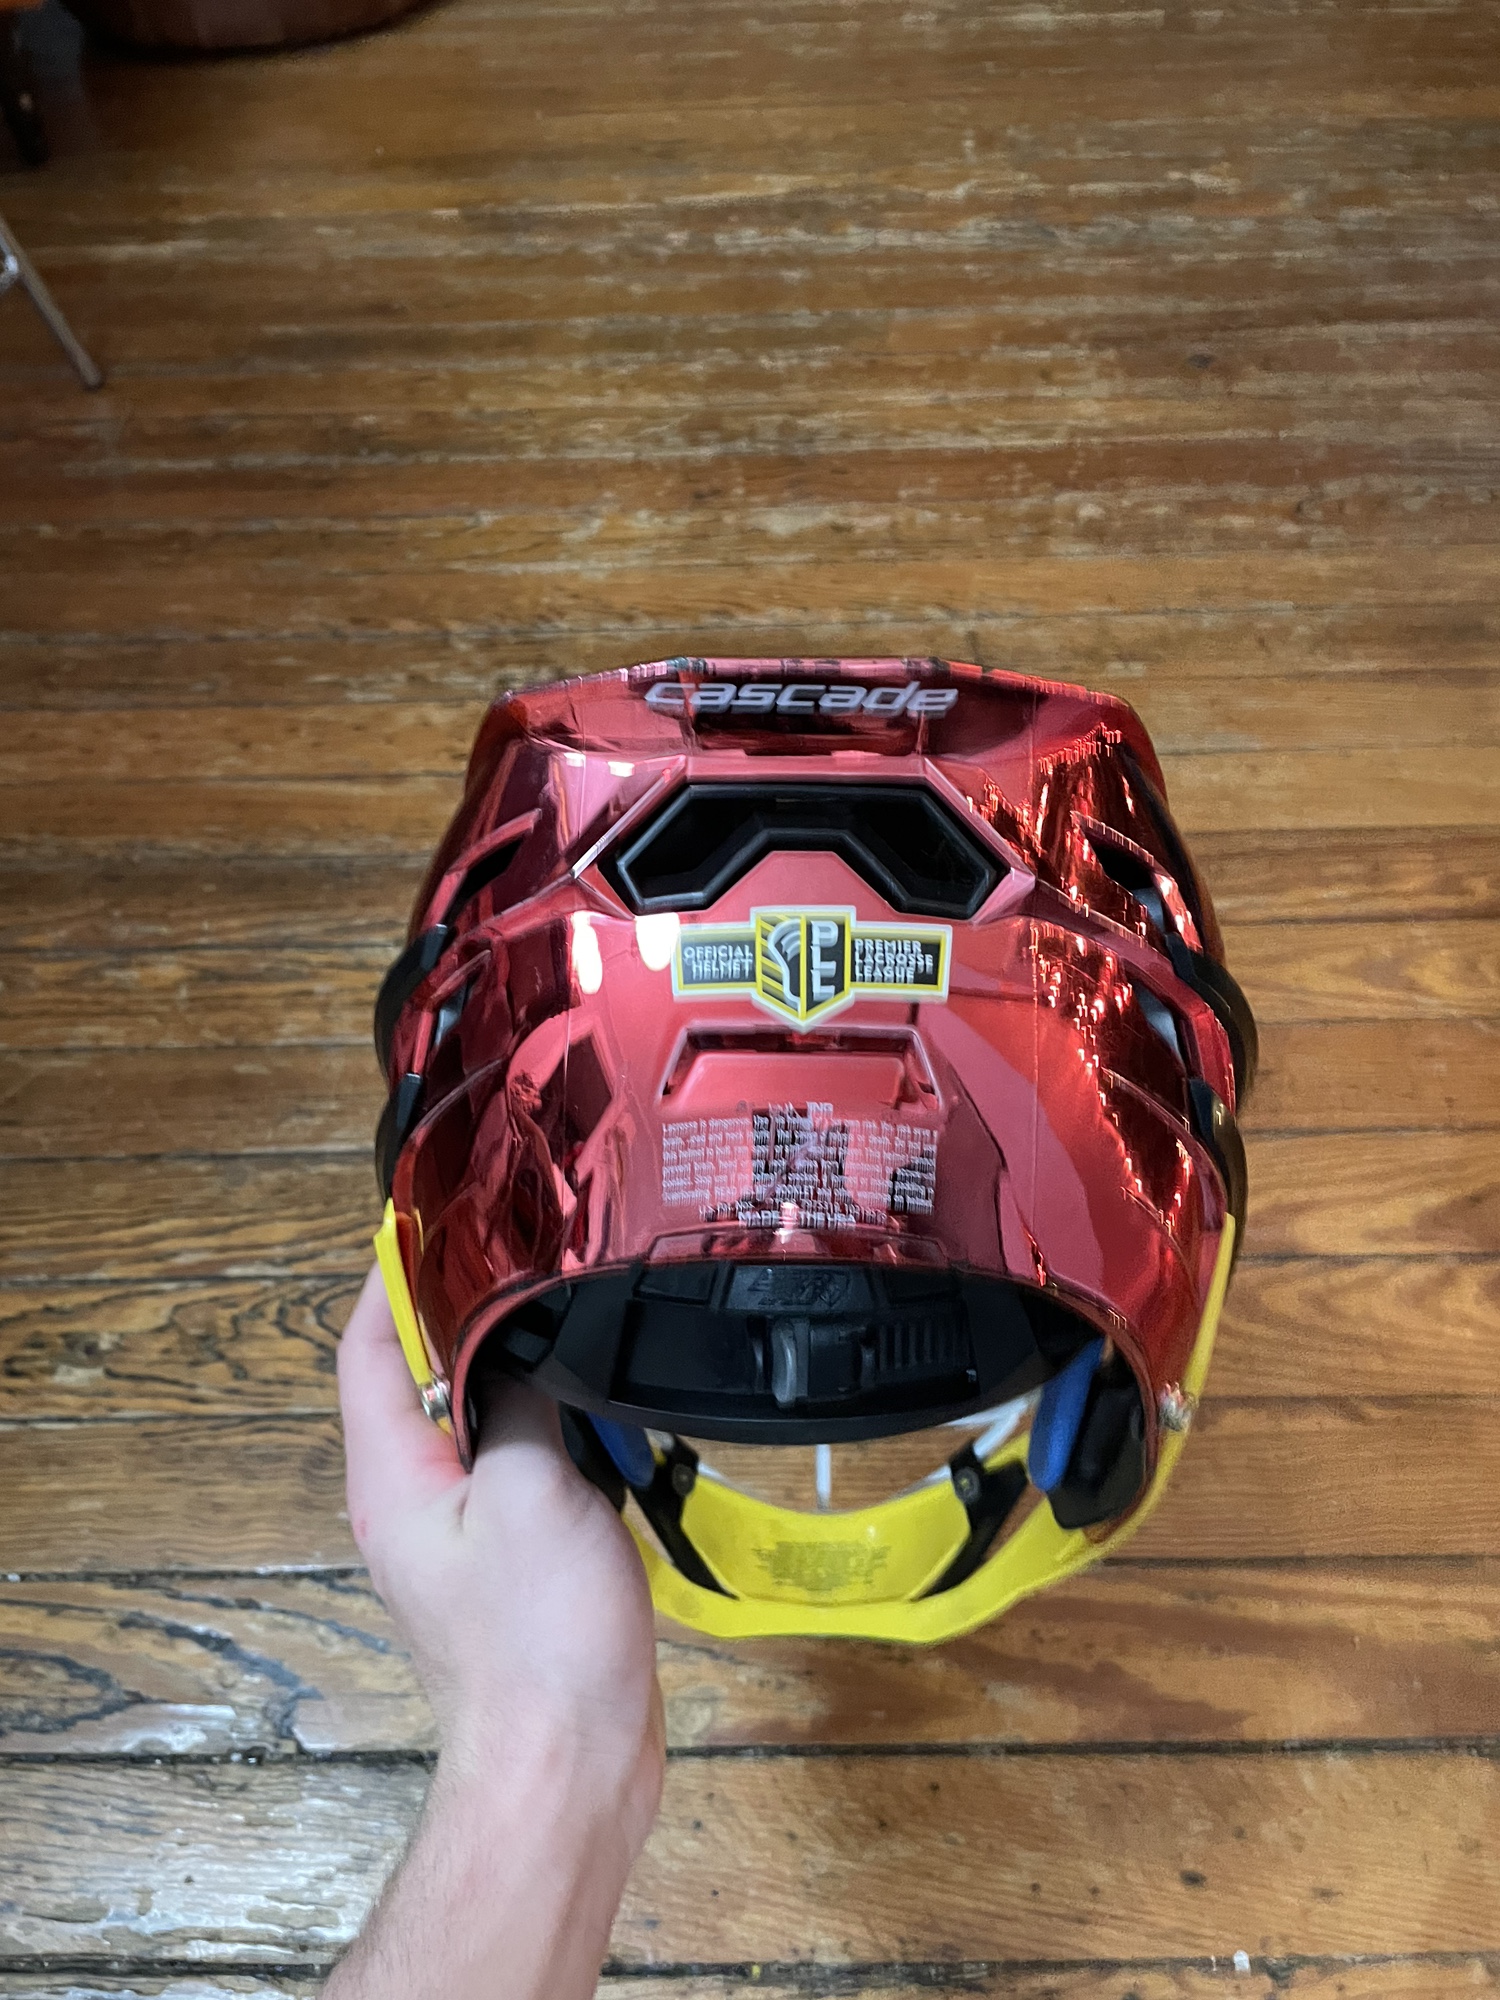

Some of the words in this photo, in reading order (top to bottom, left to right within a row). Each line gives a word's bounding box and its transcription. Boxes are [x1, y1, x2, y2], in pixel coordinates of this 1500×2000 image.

[644, 681, 958, 713] cascade
[683, 944, 754, 961] OFFICIAL
[854, 938, 922, 954] PREMIER
[692, 958, 754, 976] HELMET
[854, 951, 934, 969] LACROSSE
[854, 965, 915, 982] LEAGUE
